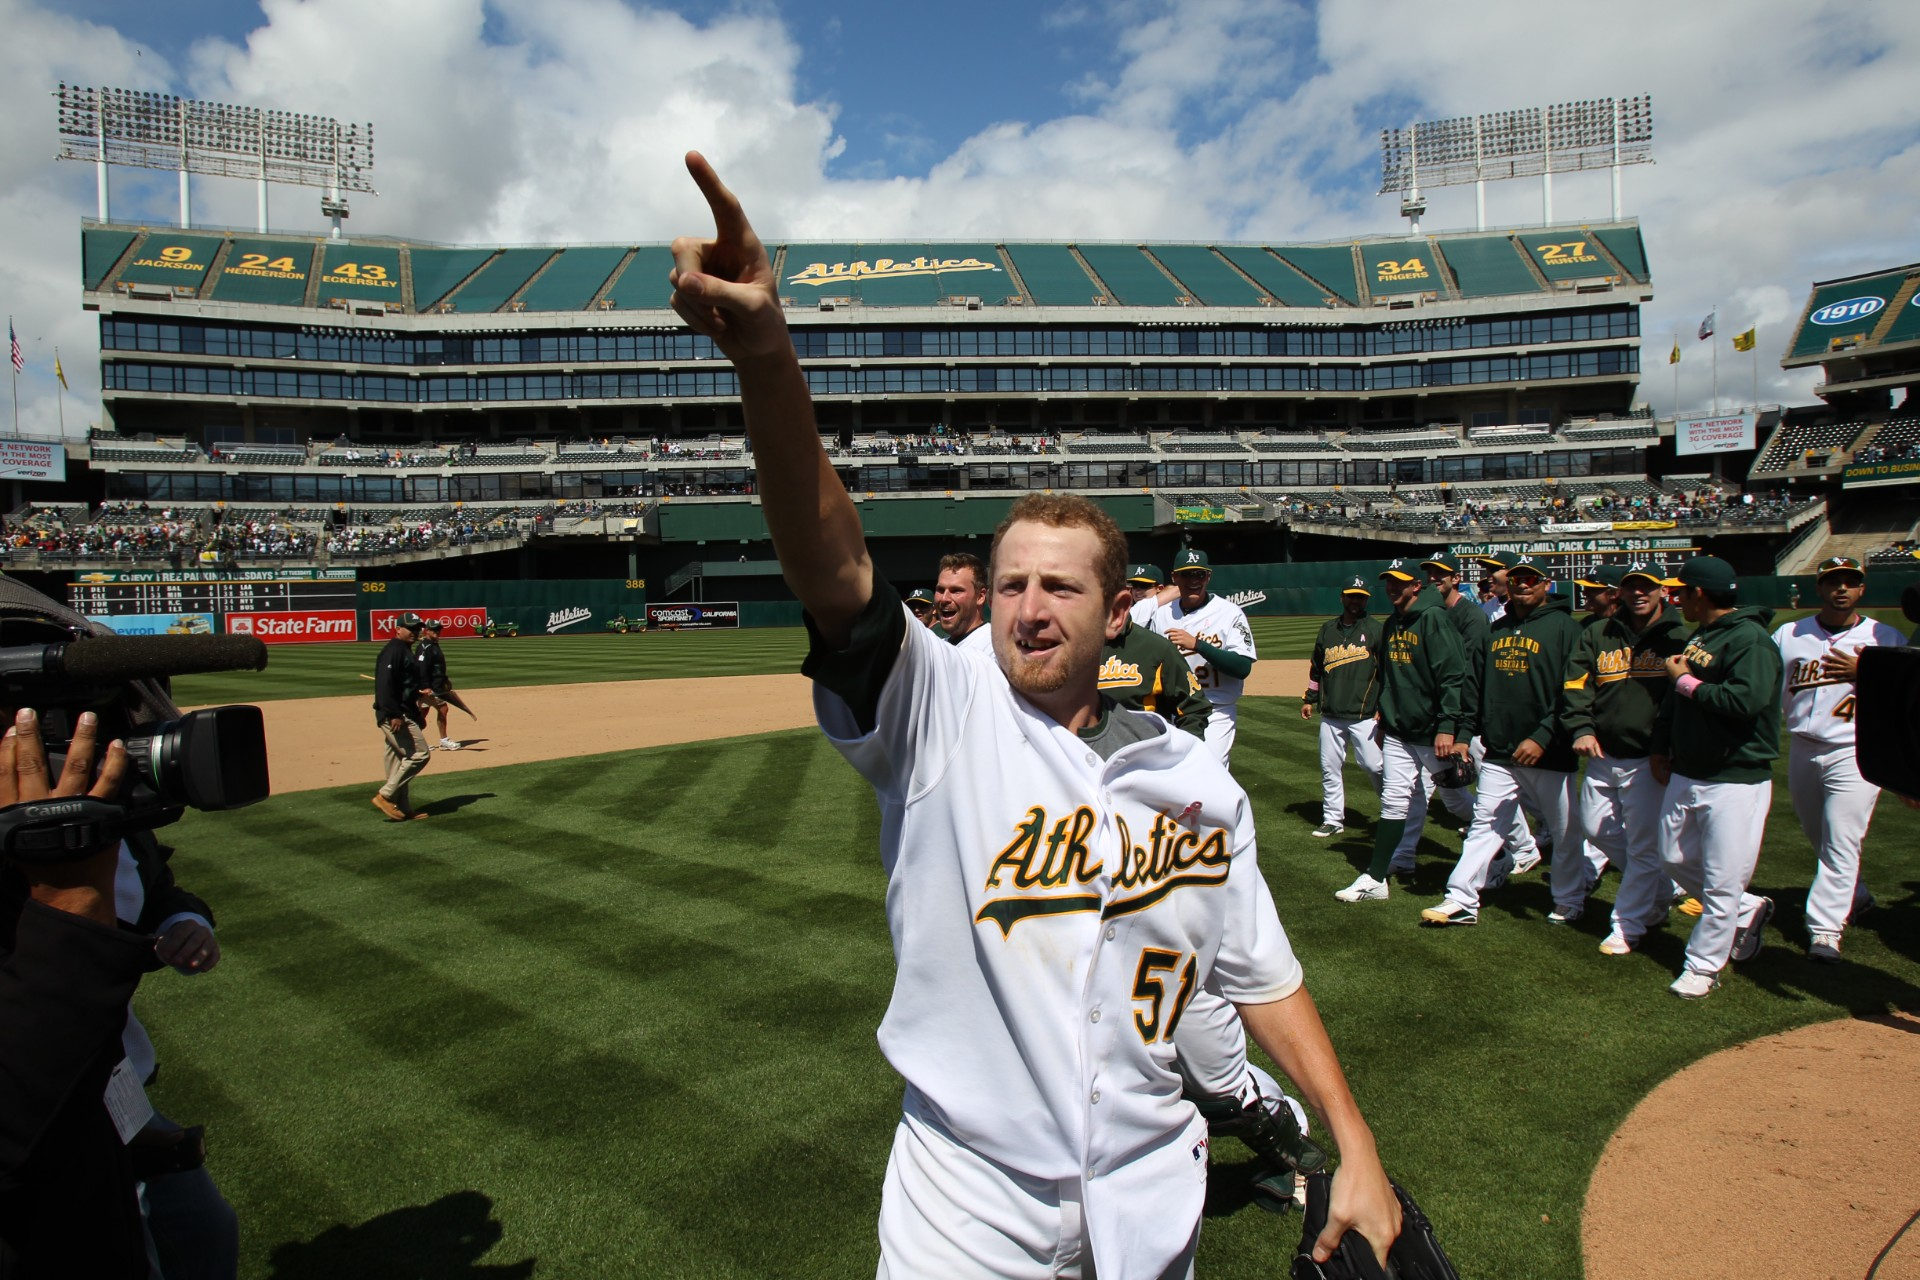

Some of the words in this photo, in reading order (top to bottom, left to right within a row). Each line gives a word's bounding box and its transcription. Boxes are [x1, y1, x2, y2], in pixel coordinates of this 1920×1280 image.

[159, 246, 192, 262] 9
[1536, 242, 1586, 260] 27
[133, 259, 204, 271] JACKSON
[238, 253, 296, 272] 24
[1545, 254, 1598, 266] HUNTER
[224, 267, 305, 280] HENDERSON
[333, 262, 388, 280] 43
[787, 256, 995, 284] Athletics
[1376, 258, 1426, 276] 34
[322, 276, 398, 288] ECKERSLEY
[1378, 271, 1430, 282] FINGERS
[1820, 300, 1878, 320] 1910
[1706, 418, 1744, 427] NETWORK
[1702, 432, 1744, 440] COVERAGE
[8, 444, 52, 452] NETWORK
[2, 458, 52, 468] COVERAGE
[16, 470, 47, 478] verizon
[1846, 467, 1874, 477] DOWN
[1876, 465, 1888, 474] TO
[1890, 463, 1920, 473] BUSIN
[1558, 541, 1584, 552] PACK
[1587, 540, 1597, 552] 4
[1626, 540, 1650, 550] $50
[1186, 552, 1200, 564] A's
[120, 574, 154, 582] CHEVY
[626, 580, 645, 588] 388
[362, 582, 386, 592] 362
[546, 606, 592, 632] Athletics
[651, 608, 688, 617] comcast
[115, 626, 155, 635] evron
[256, 618, 304, 634] State
[306, 618, 352, 634] Farm
[1491, 636, 1540, 654] OAKLAND
[1323, 642, 1370, 670] Athletics
[1098, 655, 1143, 686] etics
[1596, 646, 1667, 682] Athletic
[24, 802, 82, 818] Canon
[978, 803, 1232, 912] Athletics
[1131, 947, 1199, 1045] 51
